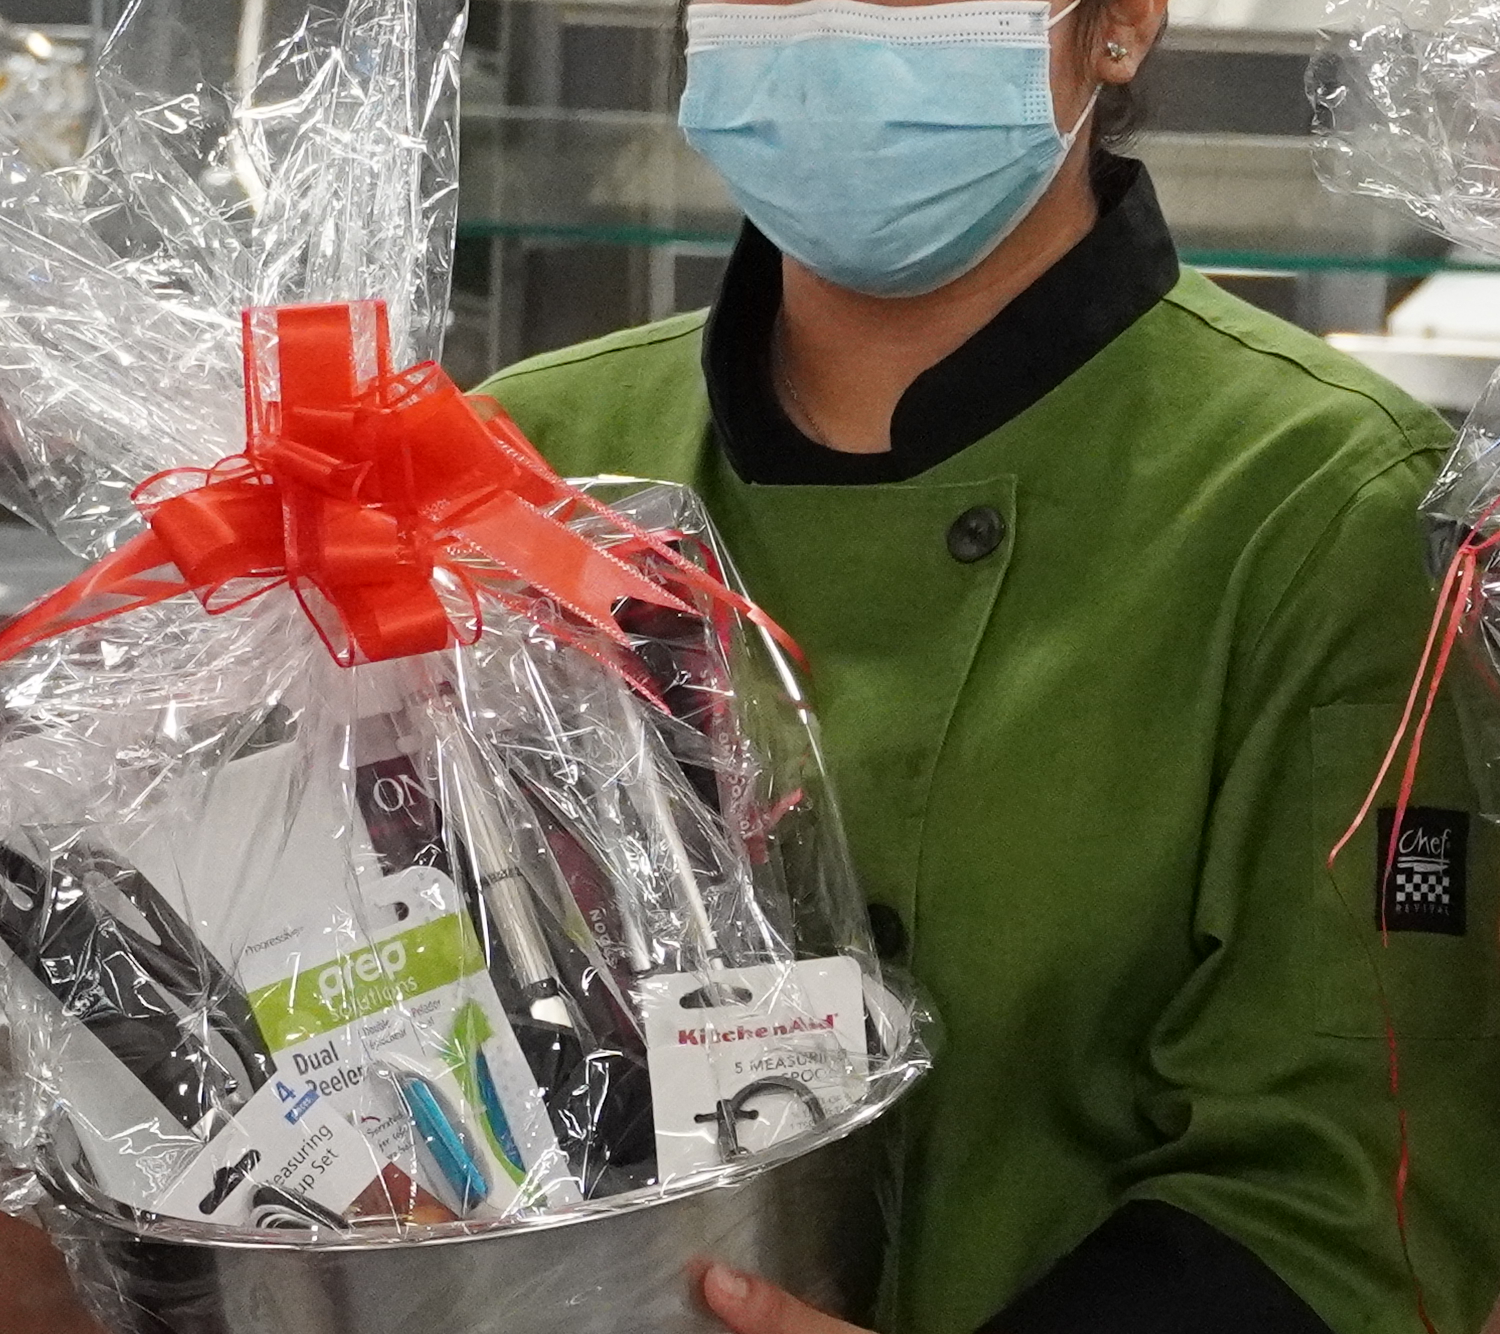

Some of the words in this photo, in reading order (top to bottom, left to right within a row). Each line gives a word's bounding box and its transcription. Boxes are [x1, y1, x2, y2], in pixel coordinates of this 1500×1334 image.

[1399, 827, 1451, 862] Chef
[318, 940, 407, 1004] prep
[293, 1040, 340, 1076] Dual
[734, 1061, 744, 1074] 5
[275, 1080, 297, 1103] 4
[267, 1124, 334, 1186] easuring
[311, 1147, 340, 1175] Set
